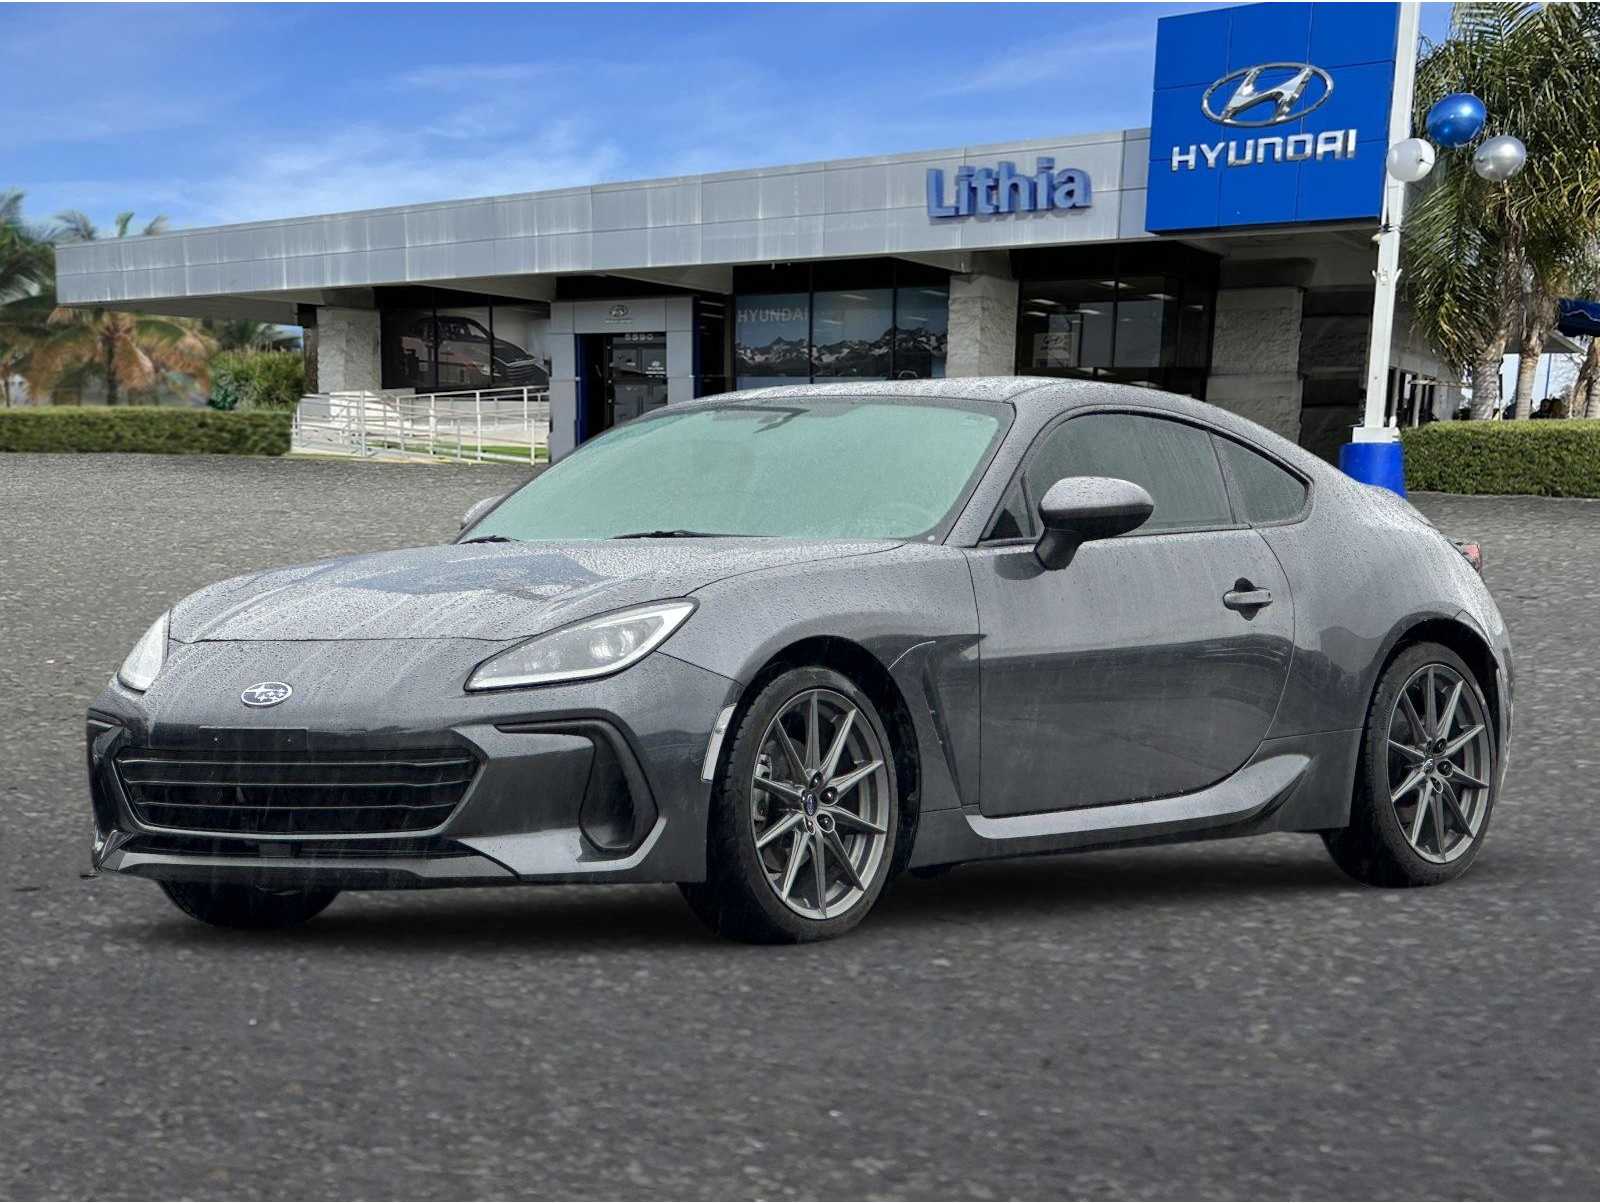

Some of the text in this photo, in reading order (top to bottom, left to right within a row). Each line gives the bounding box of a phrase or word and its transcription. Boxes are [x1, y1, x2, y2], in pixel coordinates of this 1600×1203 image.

[1171, 129, 1357, 173] HYUNDAI
[927, 158, 1092, 219] Lithia
[736, 306, 808, 322] HYUNDAI
